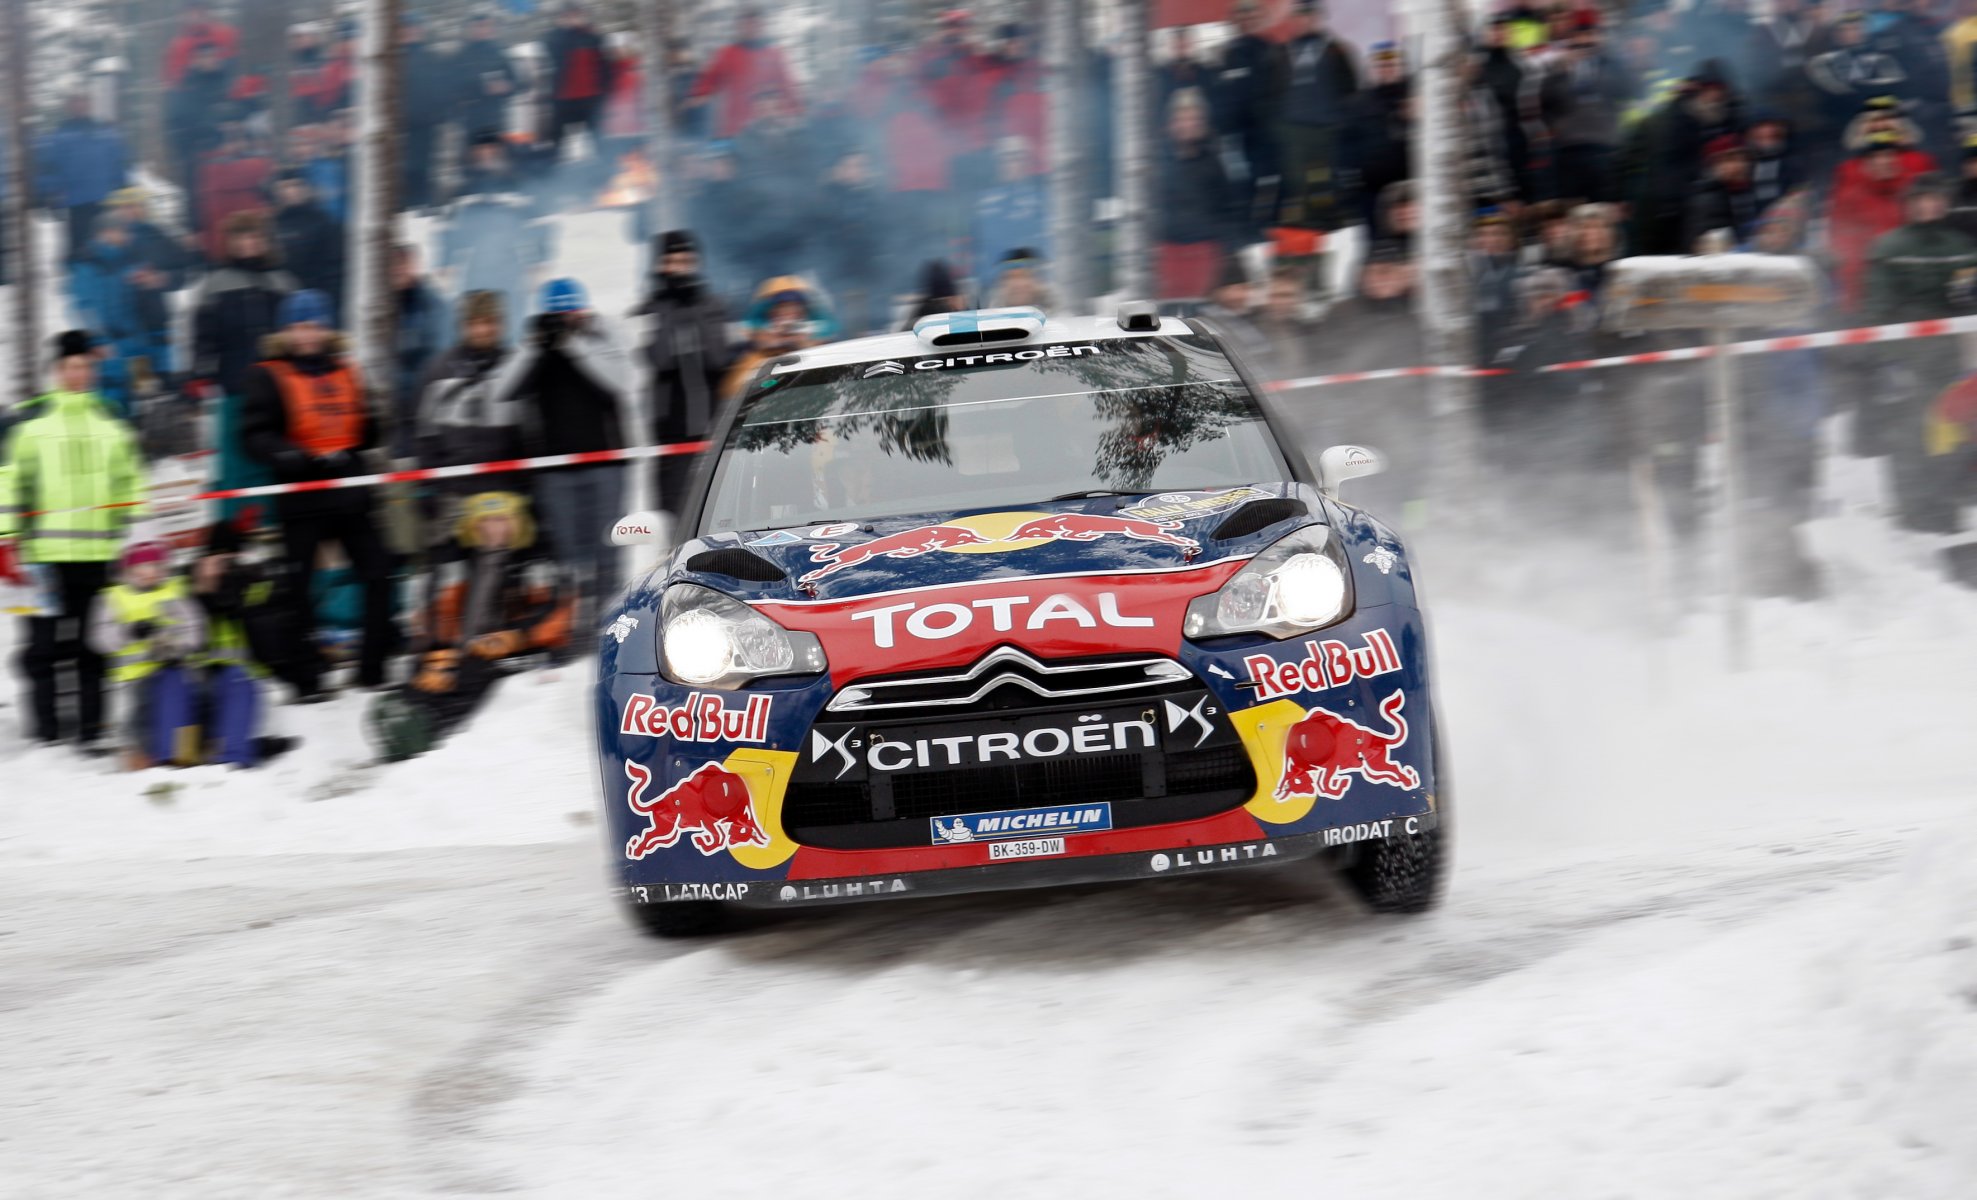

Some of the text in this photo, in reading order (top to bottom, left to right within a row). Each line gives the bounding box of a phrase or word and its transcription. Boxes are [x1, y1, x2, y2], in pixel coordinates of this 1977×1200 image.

[1128, 503, 1185, 519] RALLY
[616, 525, 651, 536] TOTAL
[821, 524, 847, 536] E
[850, 591, 1155, 649] TOTAL
[1243, 628, 1403, 702] Red Bull
[620, 691, 773, 743] Red Bull
[866, 713, 1157, 771] CITROËN
[976, 808, 1102, 833] MICHELIN
[993, 839, 1060, 858] BK-359-DW
[1176, 842, 1277, 867] LUHTA
[803, 878, 907, 900] LUHTA
